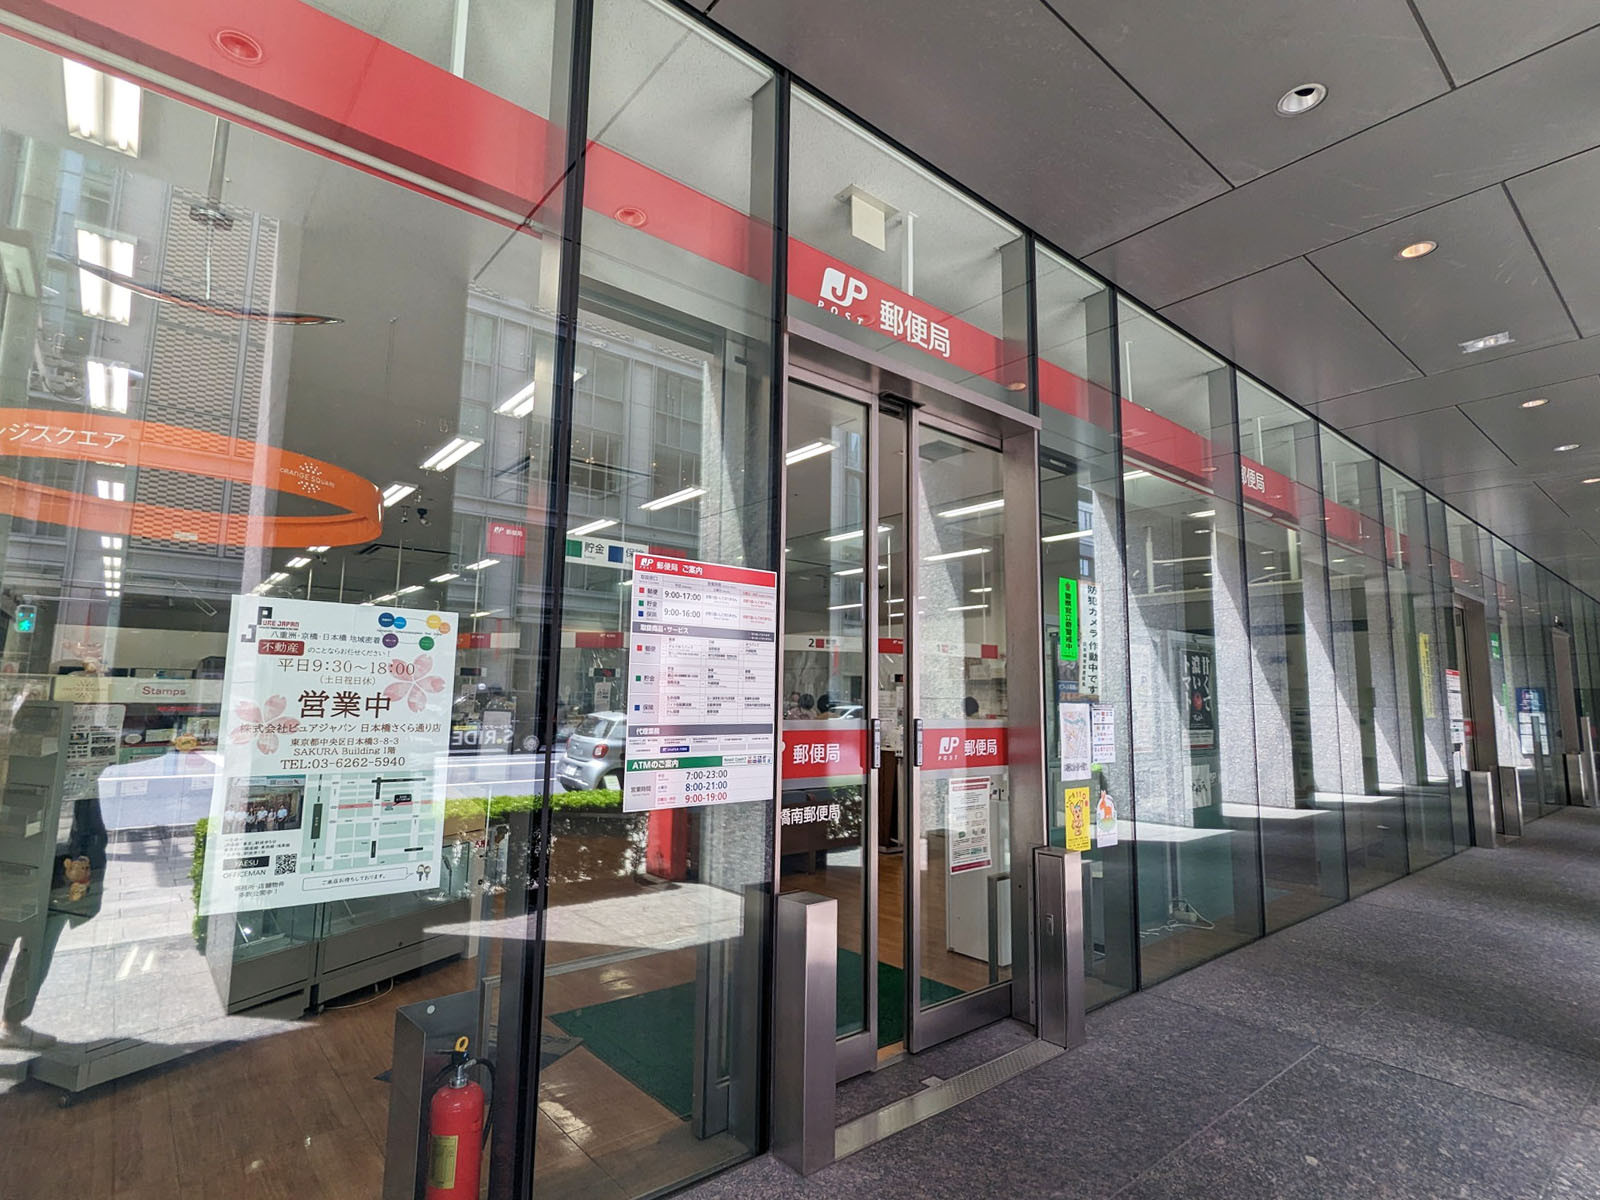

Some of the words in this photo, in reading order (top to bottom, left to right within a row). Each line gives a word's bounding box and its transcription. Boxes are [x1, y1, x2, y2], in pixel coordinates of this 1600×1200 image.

[880, 299, 951, 358] 郵便局
[280, 467, 310, 481] ORANGE
[584, 541, 605, 555] 貯金
[682, 564, 703, 575] ご案内
[664, 590, 702, 601] 9:00-17:00
[663, 607, 701, 618] 9:00-16:00
[1087, 585, 1098, 695] 防犯カメラ作動中です
[262, 642, 299, 654] 不動産
[1182, 654, 1192, 711] トマト
[1202, 655, 1212, 712] 甘くて
[142, 685, 187, 697] Stamps
[297, 690, 392, 719] 営業中
[361, 722, 442, 734] 日本橋さくら通り店
[293, 747, 339, 757] SAKURA
[341, 746, 380, 755] Building
[964, 738, 998, 757] 郵便局
[793, 743, 840, 765] 郵便局
[280, 756, 405, 770] TEL:03-6262-5940
[632, 759, 679, 770] ATMのご案内
[685, 769, 728, 780] 7:00-23:00
[685, 780, 728, 792] 8:00-21:00
[684, 792, 728, 804] 9:00-19:00
[222, 869, 267, 879] OFFICEMAN
